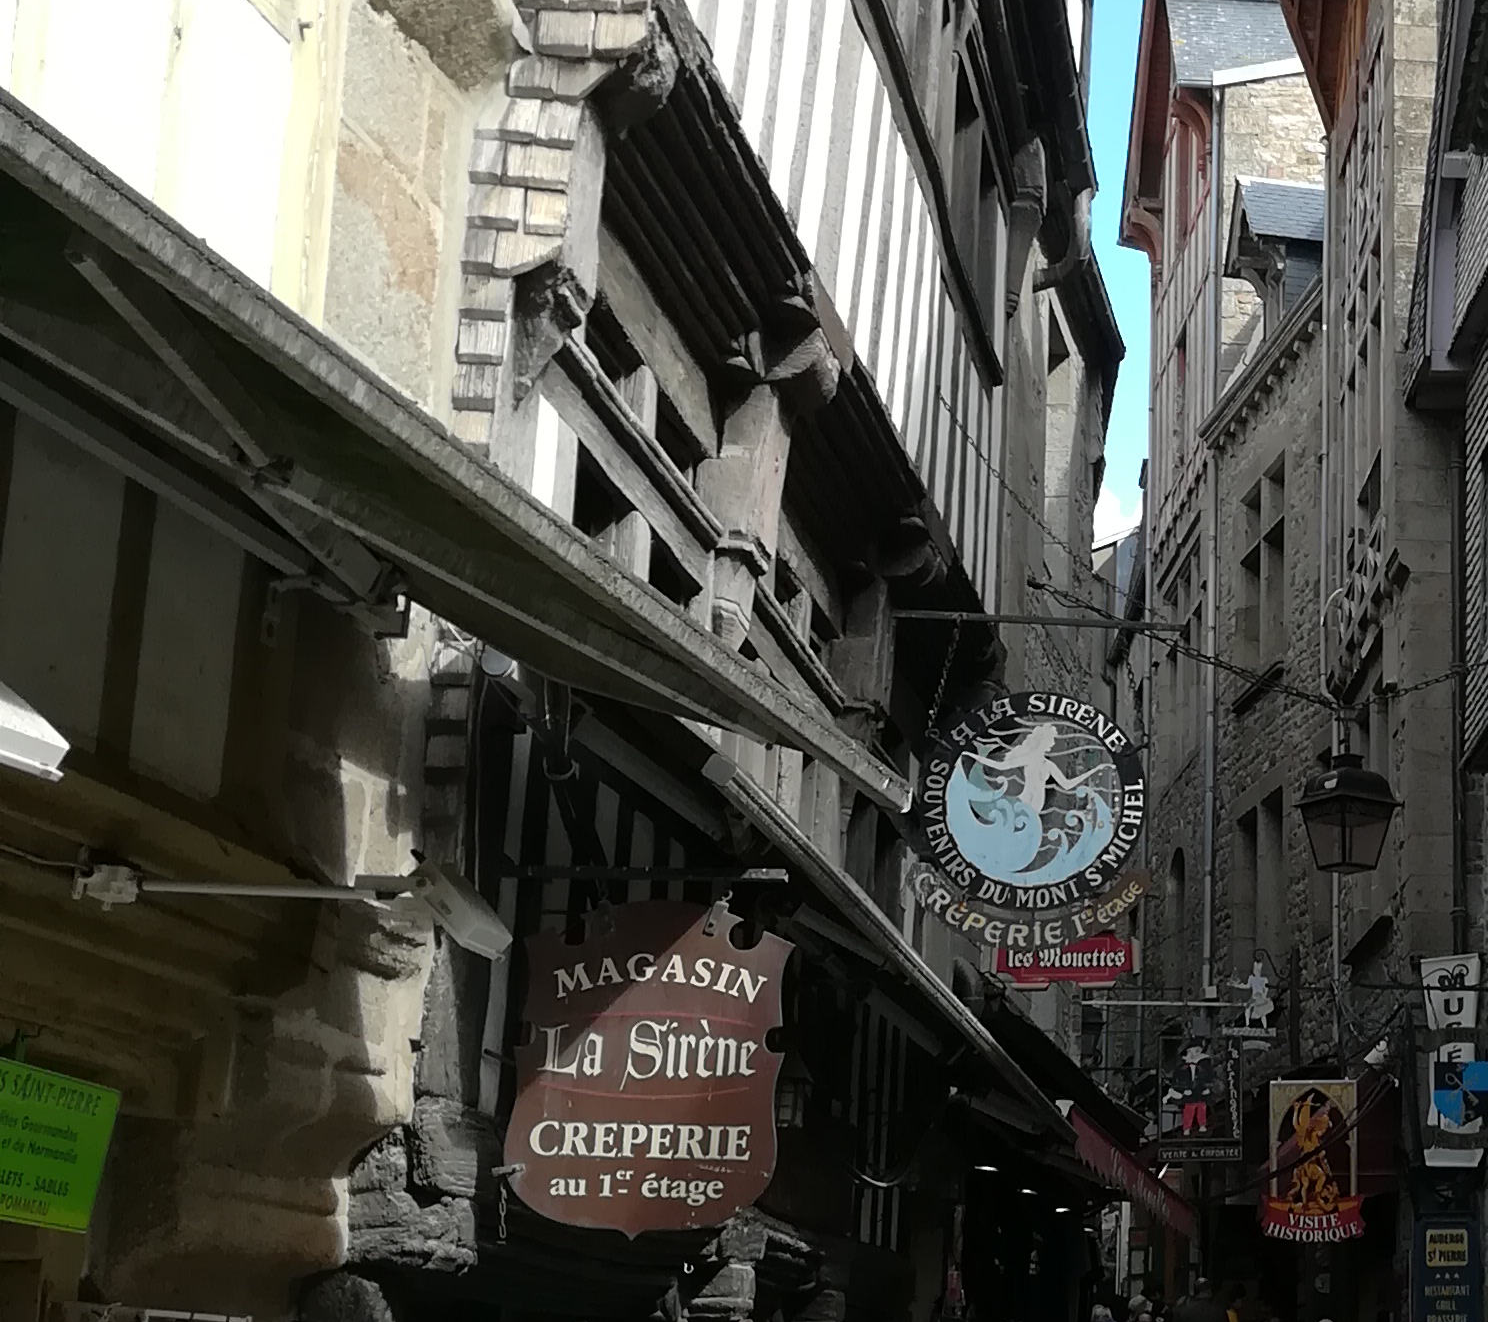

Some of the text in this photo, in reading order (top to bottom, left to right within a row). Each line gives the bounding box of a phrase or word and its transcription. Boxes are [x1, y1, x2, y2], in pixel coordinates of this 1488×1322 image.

[950, 720, 977, 746] A
[977, 696, 1017, 727] LA
[922, 758, 977, 887] SOUVENIRS
[977, 878, 1010, 905] DU
[1015, 878, 1081, 909] MONT
[1100, 777, 1145, 870] MICHEL
[1038, 946, 1126, 968] Mouettes
[553, 952, 768, 1003] MAGASIN
[537, 1019, 759, 1091] La Sirène
[529, 1121, 752, 1161] CREPERIE
[549, 1179, 587, 1197] au
[641, 1173, 725, 1206] étage
[1266, 1221, 1361, 1243] HISTORIQUE
[1288, 1213, 1339, 1229] VISITE
